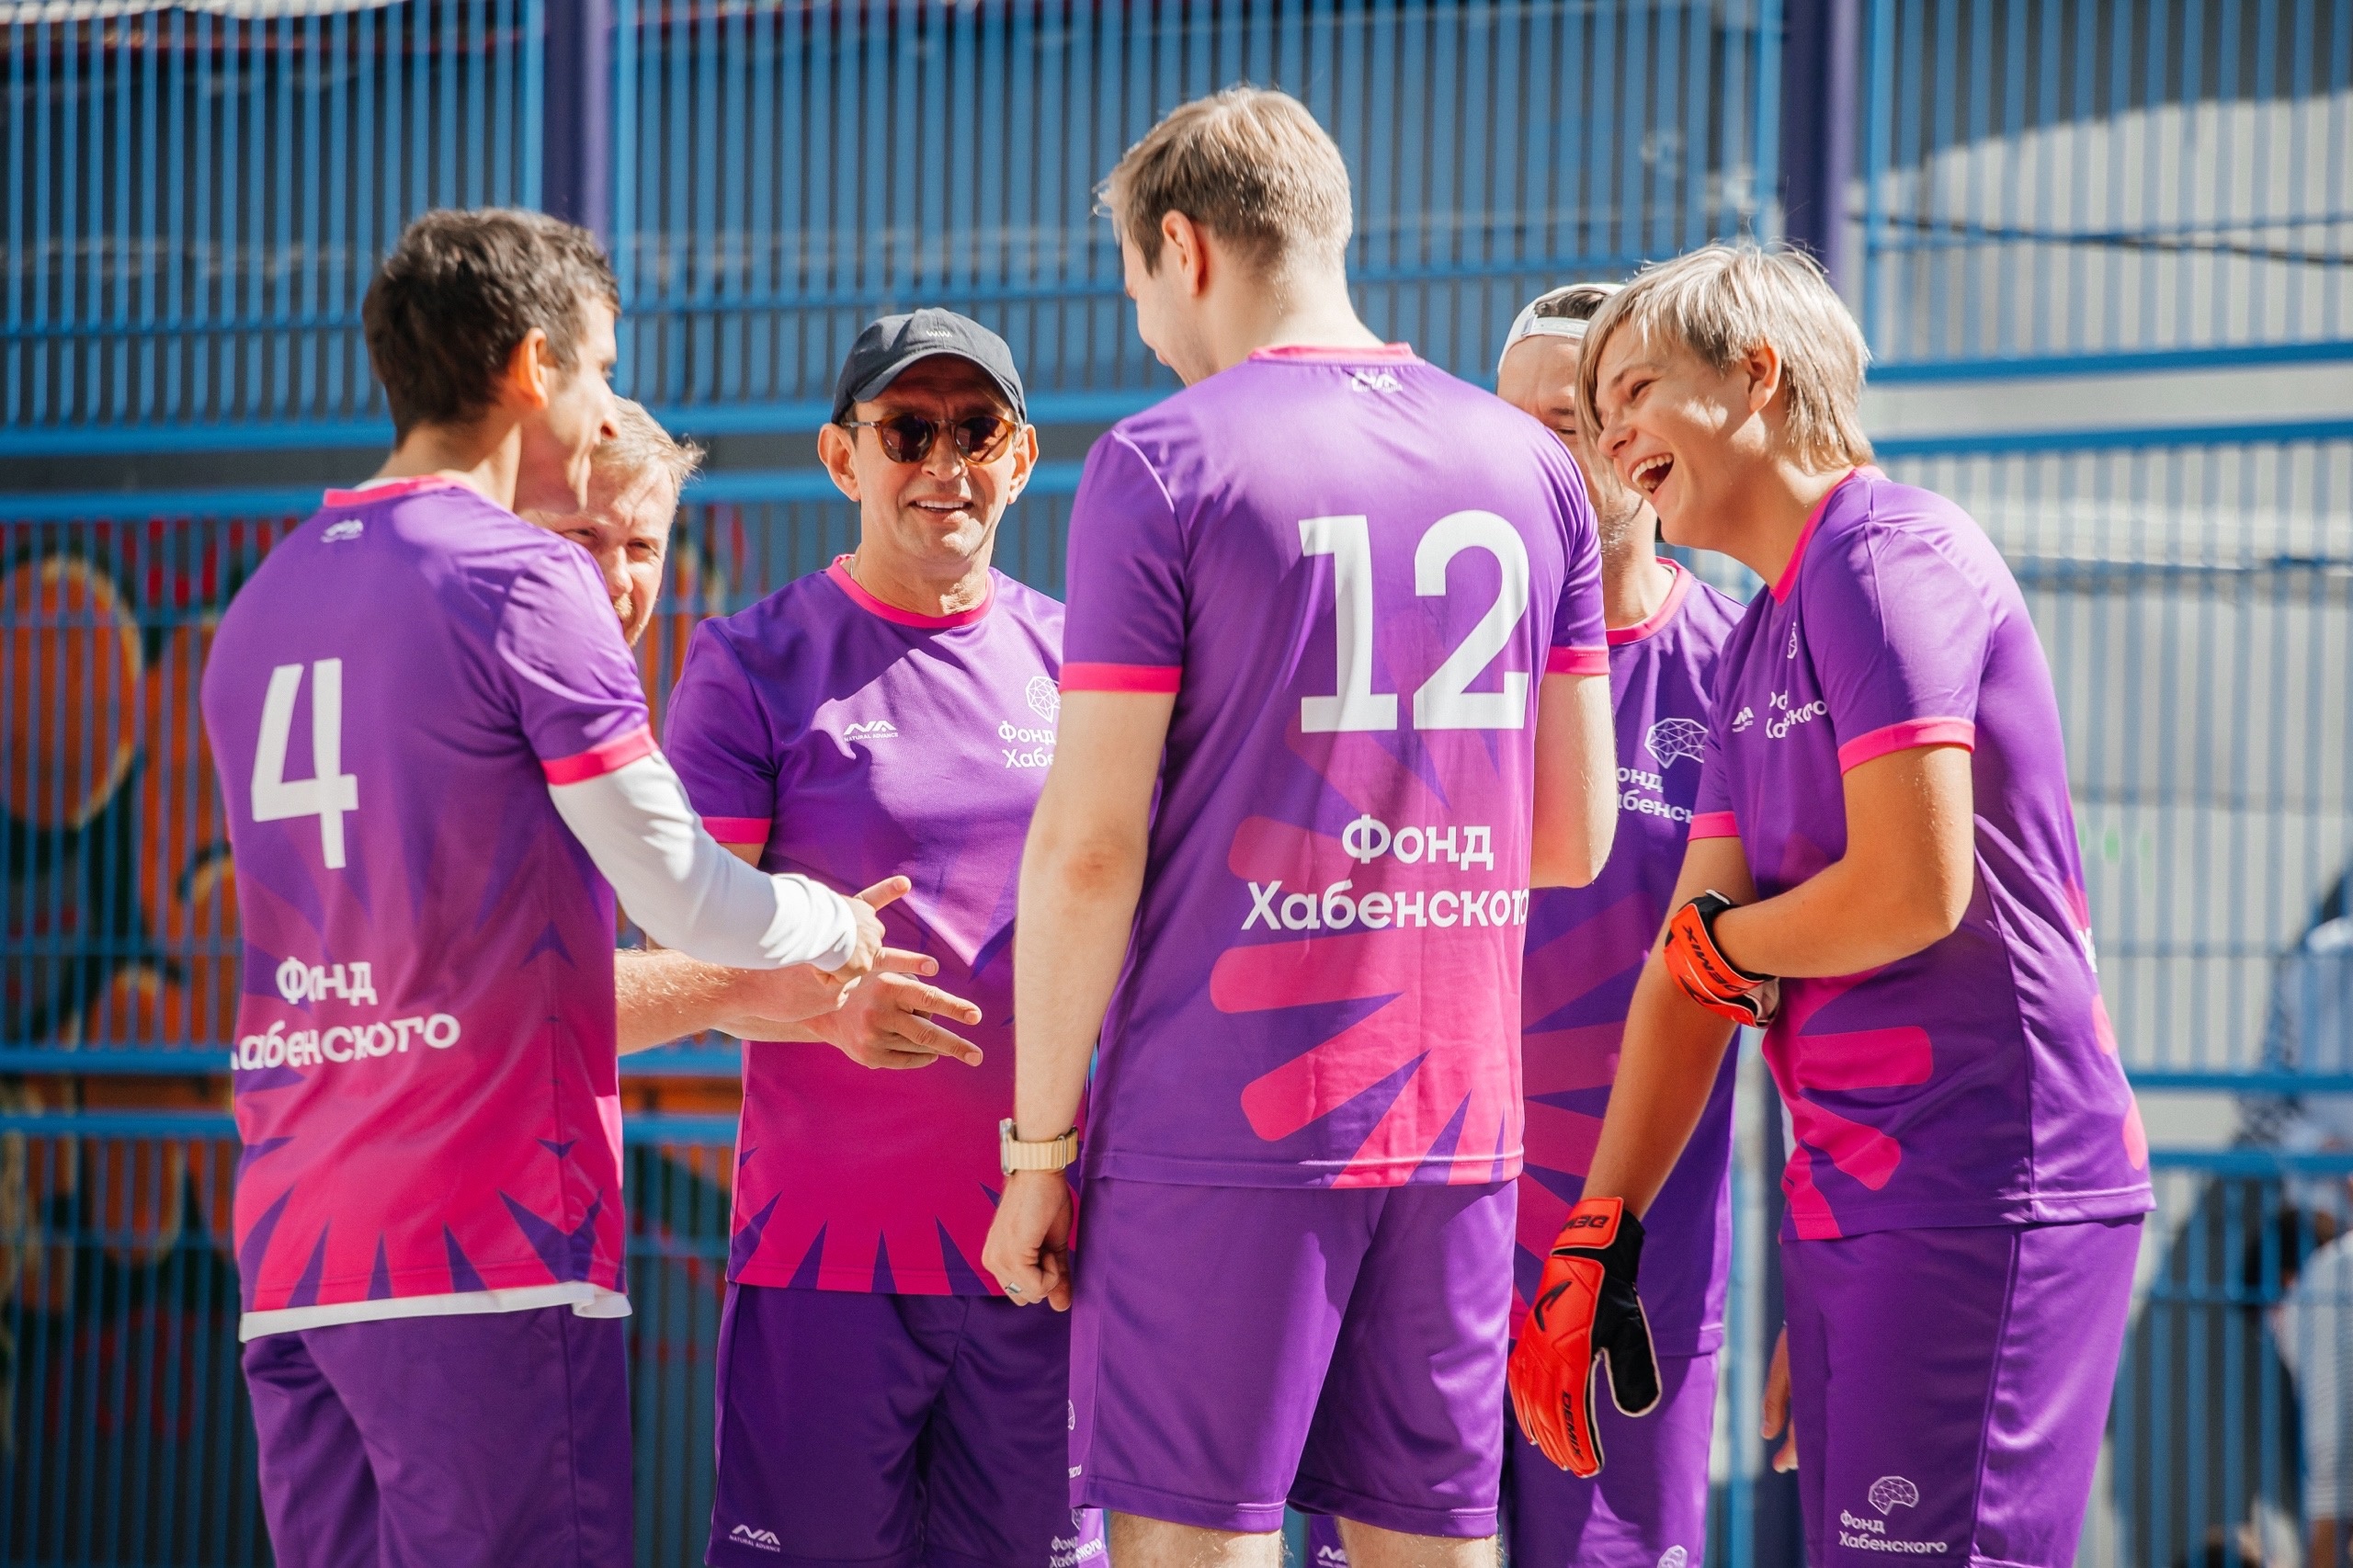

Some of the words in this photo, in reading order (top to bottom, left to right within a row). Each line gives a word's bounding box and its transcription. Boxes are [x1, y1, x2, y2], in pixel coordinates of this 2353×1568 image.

[1298, 509, 1529, 733] 12
[844, 733, 871, 743] NATURAL
[997, 720, 1057, 745] Фонд
[251, 657, 359, 869] 4
[1616, 767, 1664, 793] онд
[1341, 813, 1495, 871] Фонд
[1682, 925, 1749, 994] DEMIX
[231, 1012, 461, 1071] абенского
[1562, 1390, 1585, 1460] DEMIX
[729, 1534, 755, 1546] NATURAL
[755, 1541, 781, 1552] ADVANCE
[1838, 1529, 1948, 1553] Хабенского
[1839, 1509, 1886, 1535] Фонд
